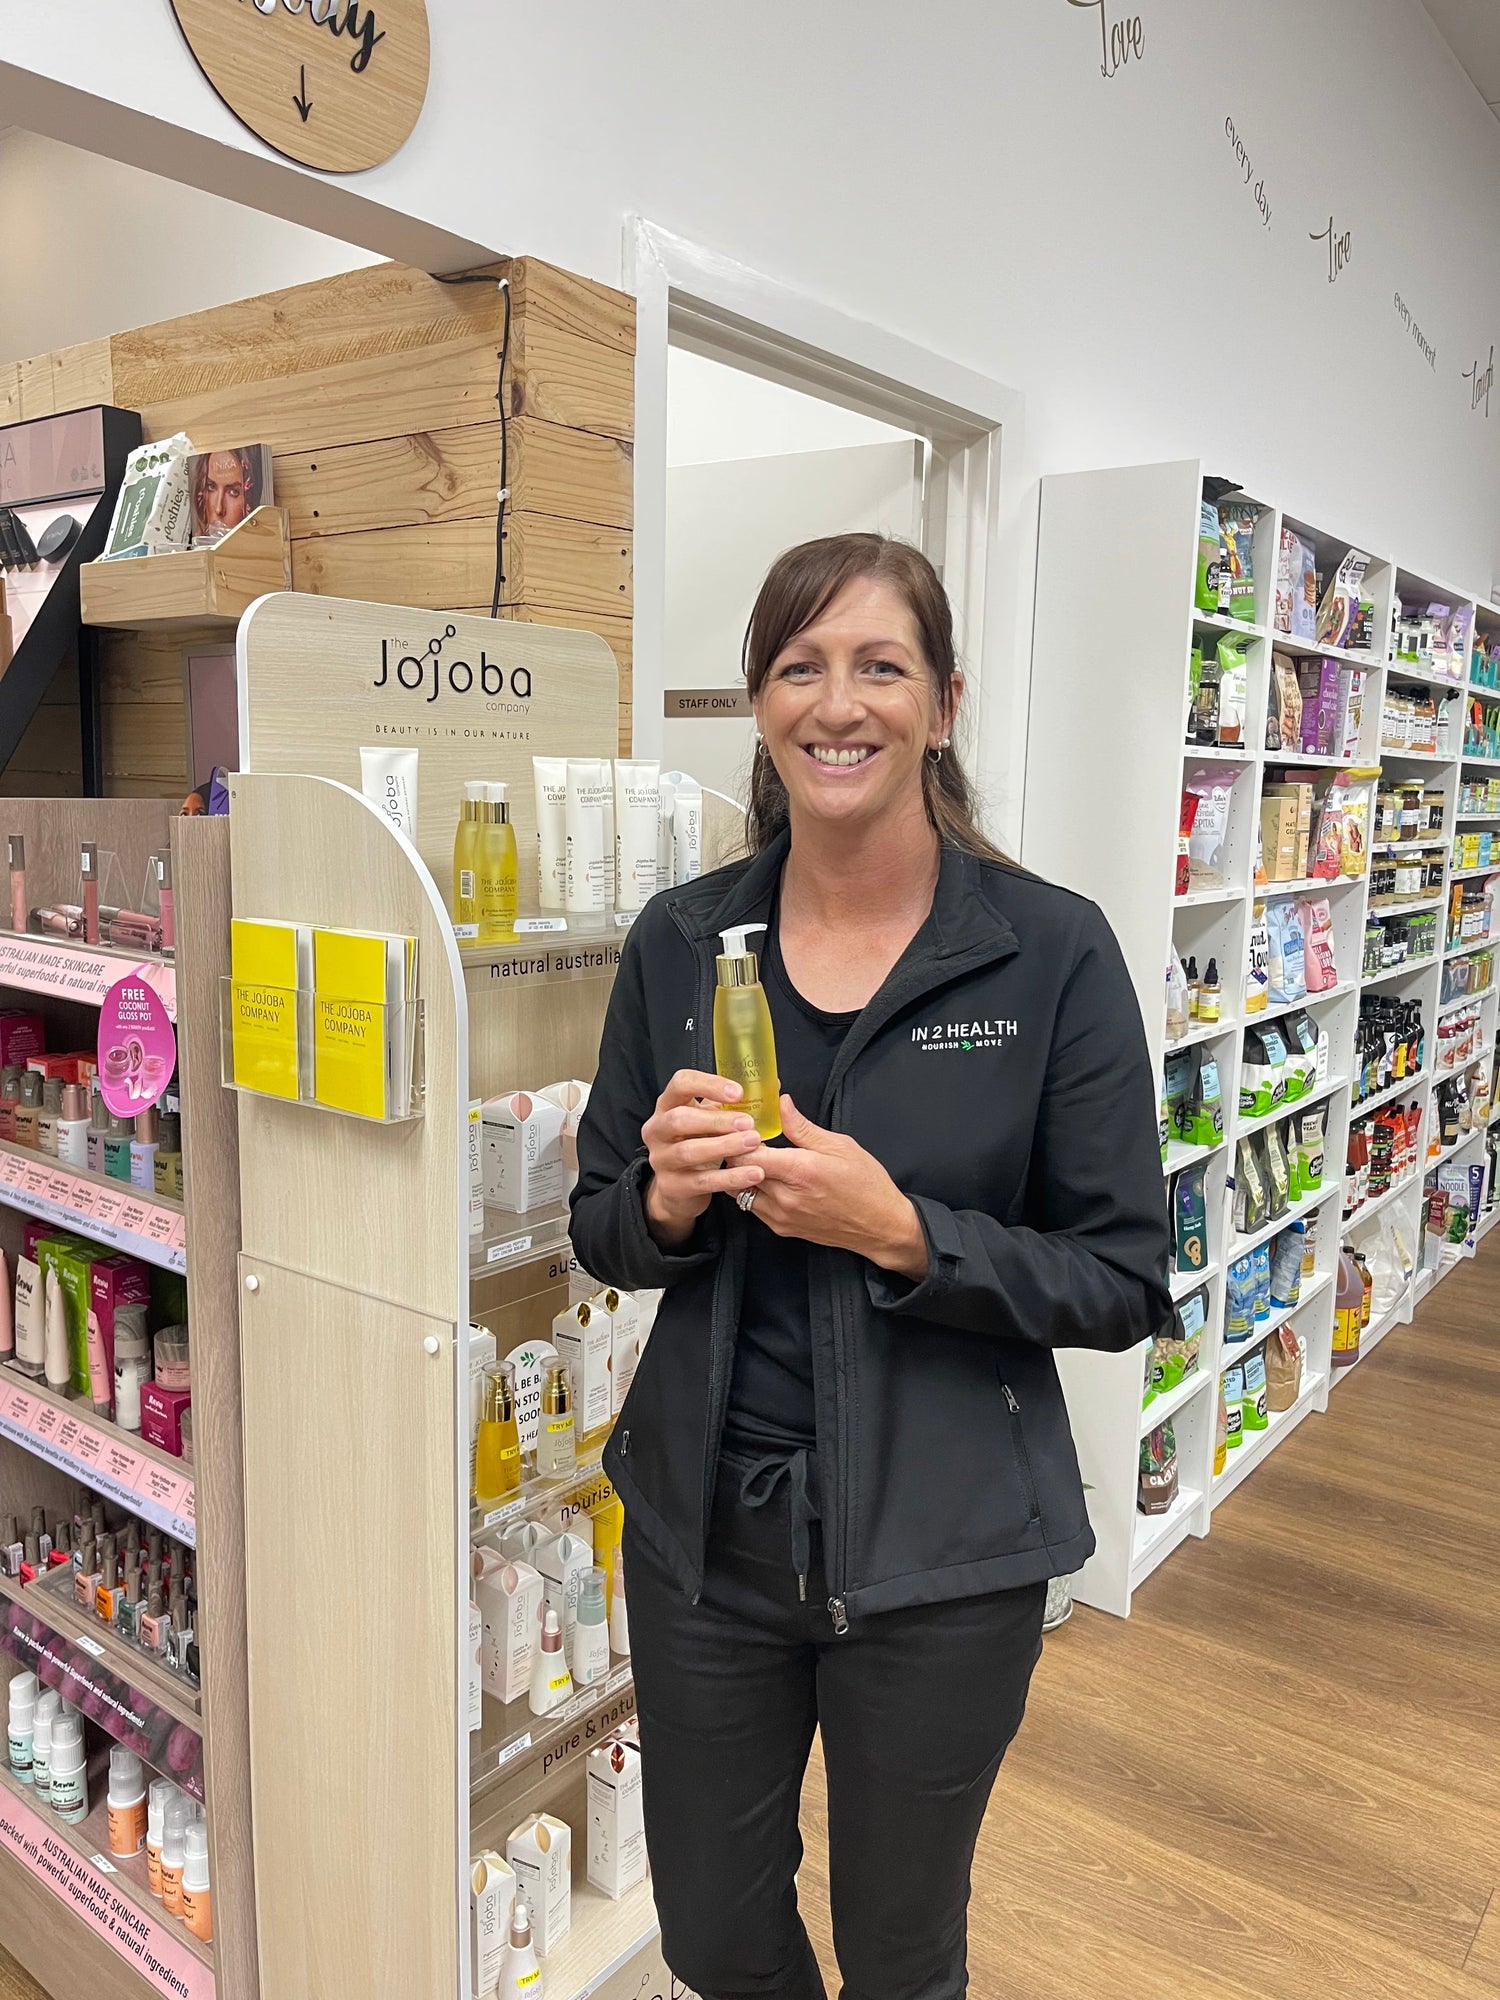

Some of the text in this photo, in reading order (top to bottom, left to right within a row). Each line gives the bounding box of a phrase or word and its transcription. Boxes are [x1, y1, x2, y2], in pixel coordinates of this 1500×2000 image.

[1066, 0, 1145, 78] Love
[1225, 117, 1254, 183] every
[1309, 216, 1351, 283] Live
[390, 637, 409, 650] the
[373, 638, 532, 703] Jojoba
[485, 701, 530, 716] company
[678, 698, 738, 709] STAFF ONLY
[375, 724, 531, 741] BEAUTY IS IN OUR NATURE
[547, 793, 566, 802] COMP
[0, 947, 106, 977] STRALIAN MADE SKINCARE
[490, 952, 550, 979] natural
[16, 966, 59, 985] superfoods
[59, 975, 66, 986] &
[66, 977, 97, 992] natural
[121, 988, 145, 1001] FREE
[236, 988, 285, 1009] THE JOJOBA
[118, 1001, 150, 1011] COCONUT
[118, 1011, 152, 1021] GLOSS POT
[240, 1004, 280, 1024] COMPANY
[320, 1000, 372, 1023] THE JOJOBA
[324, 1018, 367, 1038] COMPANY
[911, 1020, 1018, 1042] IN 2 HEALTH
[921, 1039, 1003, 1051] NOURISH MOVE
[1471, 1166, 1480, 1179] 5
[1440, 1182, 1465, 1192] NOODLE
[523, 1391, 540, 1407] STO
[543, 1735, 581, 1775] pure
[585, 1719, 598, 1739] &
[42, 1837, 88, 1884] AUSTRALIAN
[88, 1877, 110, 1906] MADE
[110, 1898, 151, 1941] SKINCARE
[23, 1838, 38, 1859] with
[36, 1851, 71, 1887] powerful
[68, 1882, 108, 1924] superfoods
[108, 1917, 116, 1931] &
[115, 1925, 145, 1958] natural
[144, 1948, 190, 1999] ingredients
